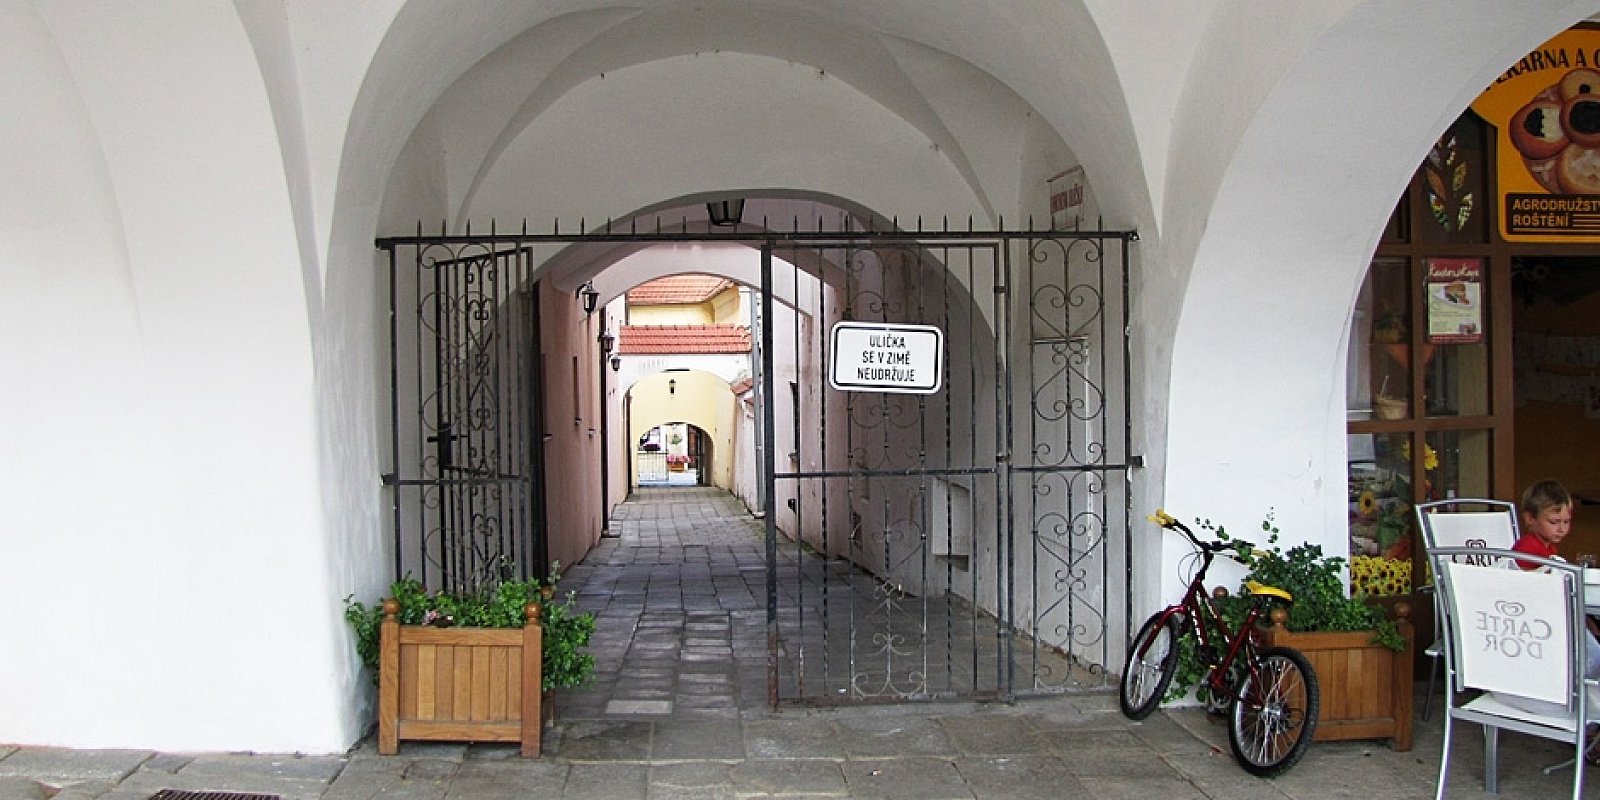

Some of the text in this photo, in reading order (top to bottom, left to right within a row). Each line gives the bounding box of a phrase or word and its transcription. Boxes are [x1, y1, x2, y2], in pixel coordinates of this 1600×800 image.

[1576, 48, 1587, 67] A
[1513, 197, 1600, 212] AGRODRUŽST
[869, 334, 906, 349] ULIČKA
[862, 350, 911, 365] SE V ZIMĚ
[857, 366, 915, 382] NEUDRŽUJE
